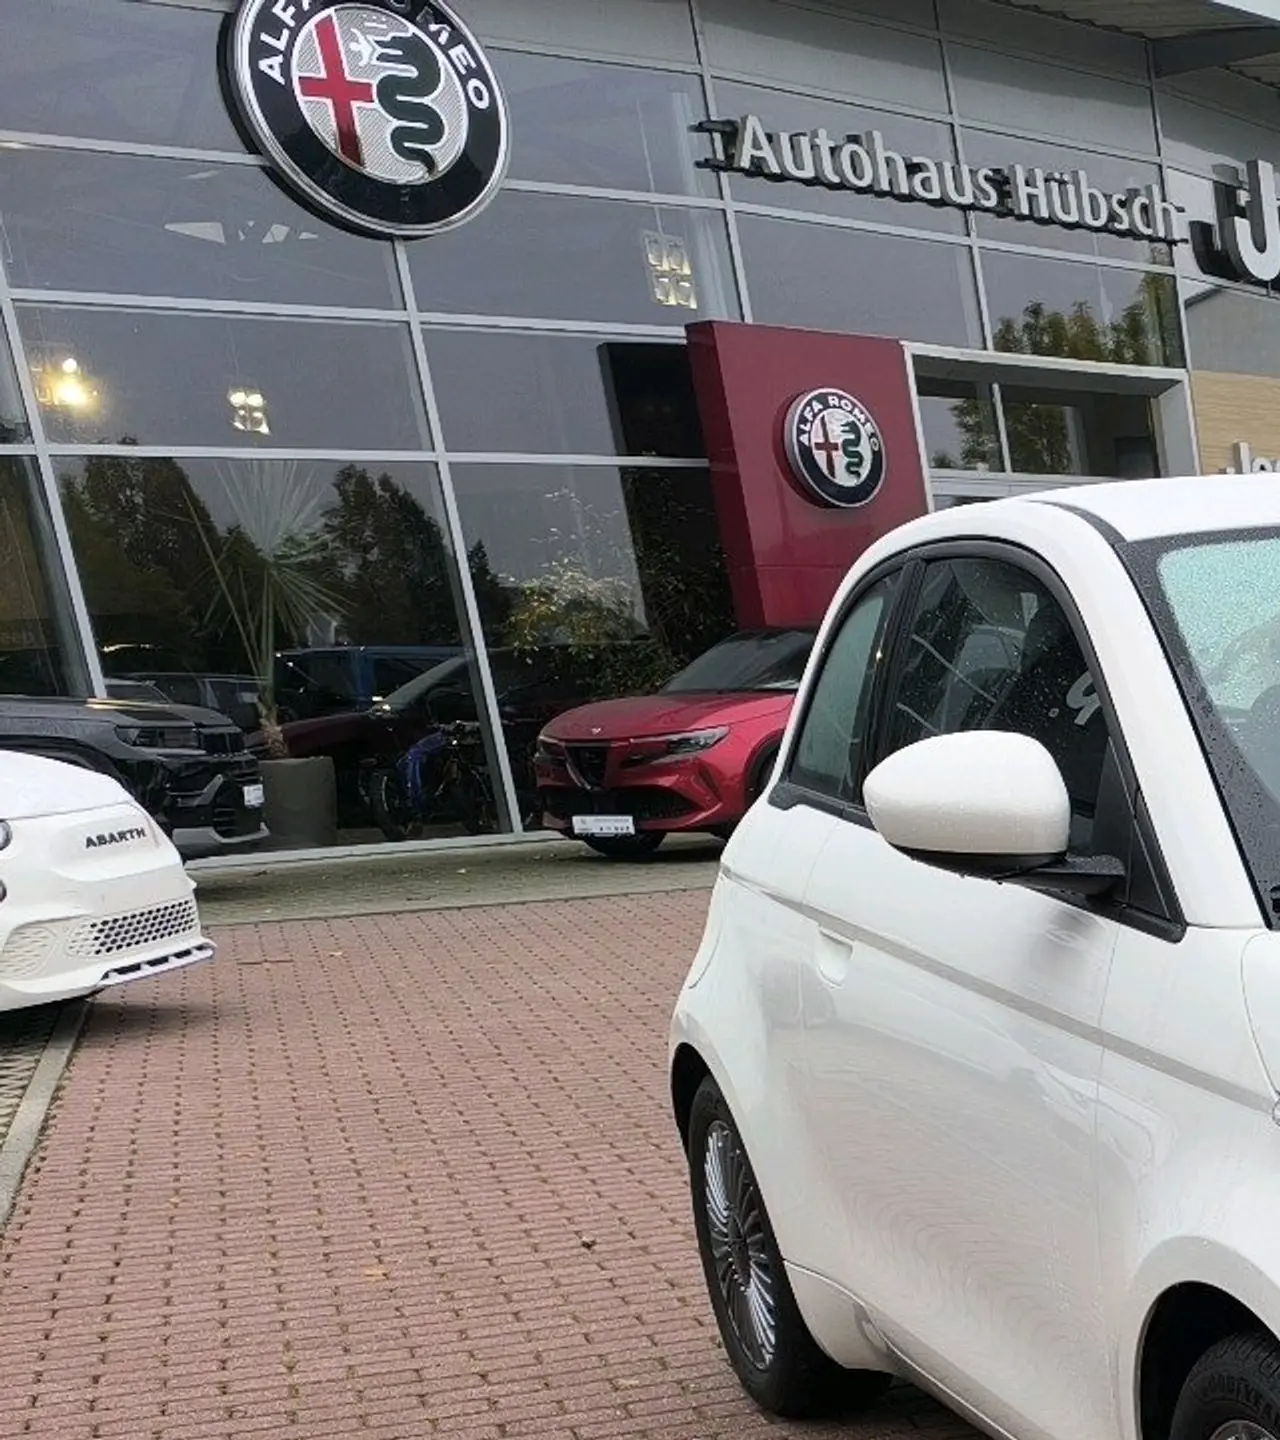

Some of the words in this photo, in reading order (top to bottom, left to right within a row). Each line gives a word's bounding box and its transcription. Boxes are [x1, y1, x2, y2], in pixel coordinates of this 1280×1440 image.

[258, 0, 310, 85] ALF
[737, 113, 999, 209] Autohaus
[1012, 163, 1179, 238] Hübsch
[799, 400, 824, 447] ALFA
[85, 827, 147, 849] ABARTH
